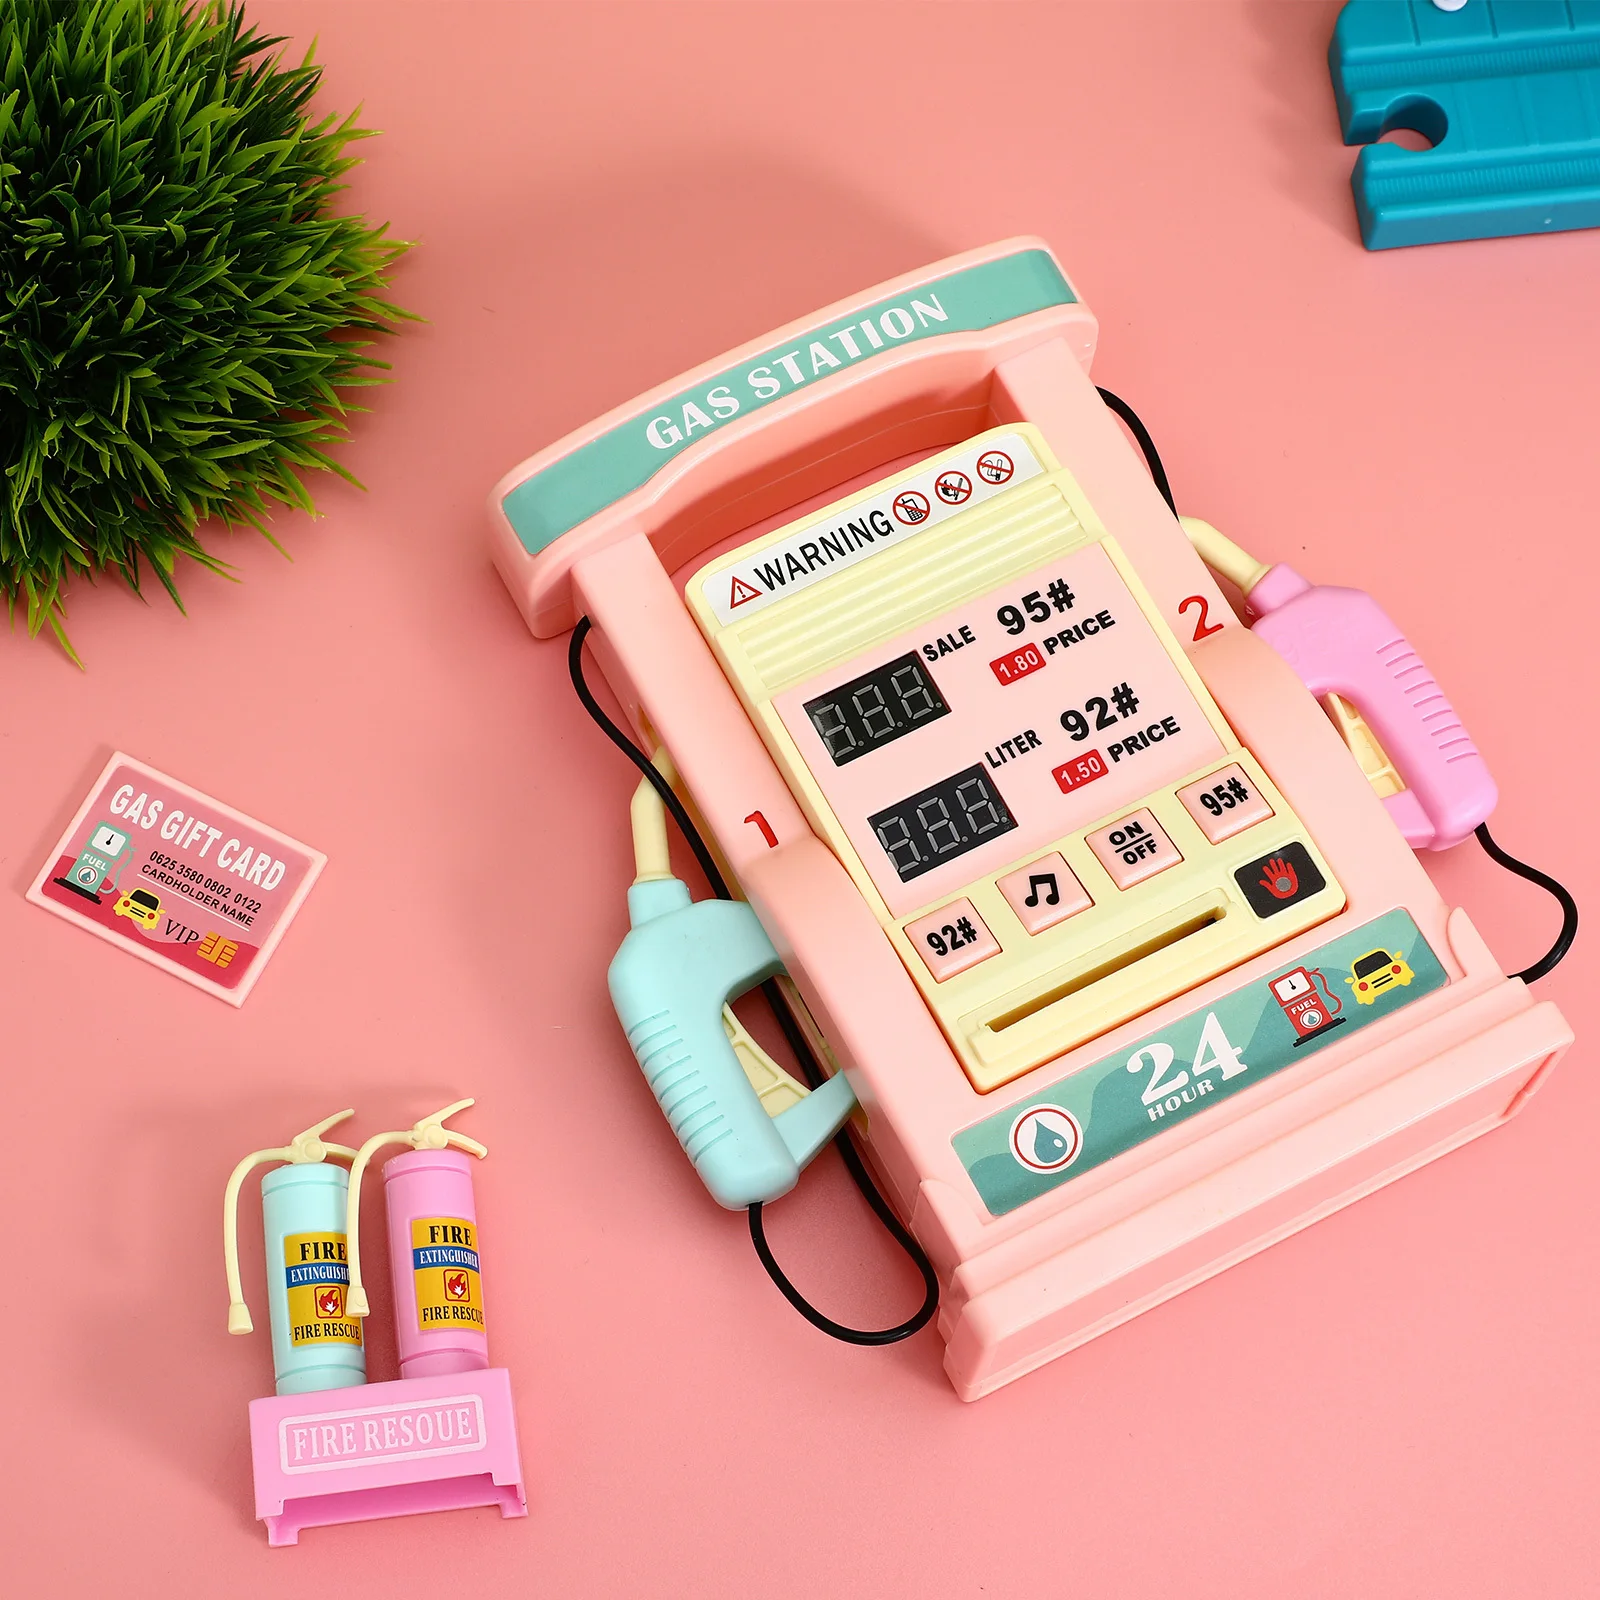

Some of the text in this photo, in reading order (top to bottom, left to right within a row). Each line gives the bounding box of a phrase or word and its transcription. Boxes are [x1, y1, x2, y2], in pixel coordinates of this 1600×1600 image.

[646, 294, 949, 450] GAS STATION
[753, 510, 895, 591] WARNING
[997, 578, 1076, 636] 95#
[1178, 595, 1225, 641] 2
[922, 625, 976, 662] SALE
[998, 610, 1115, 680] 1.80 PRICE
[1060, 682, 1140, 742] 92#
[985, 730, 1043, 769] LITER
[1060, 715, 1180, 787] 1.50 PRICE
[1199, 776, 1249, 817] 95#
[110, 784, 286, 891] GAS GIFT CARD
[743, 810, 779, 849] 1
[1108, 821, 1145, 846] ON
[82, 853, 107, 871] FUEL
[1122, 839, 1159, 866] OFF
[142, 864, 255, 926] CARDHOLDER NAME
[150, 851, 262, 914] 0625 3580 0802 0122
[163, 919, 200, 945] VIP
[926, 916, 979, 957] 92#
[1291, 999, 1317, 1015] FUEL
[1126, 1011, 1248, 1106] 24
[1147, 1079, 1215, 1123] HOUR
[300, 1241, 347, 1261] FIRE
[429, 1225, 472, 1246] FIRE
[291, 1265, 350, 1283] EXTINGUISHE
[419, 1249, 479, 1268] EXTINGUISHER
[294, 1323, 360, 1341] FIRE RESCUE
[422, 1306, 484, 1325] FIRE RESCUE
[292, 1422, 357, 1461] FIRE
